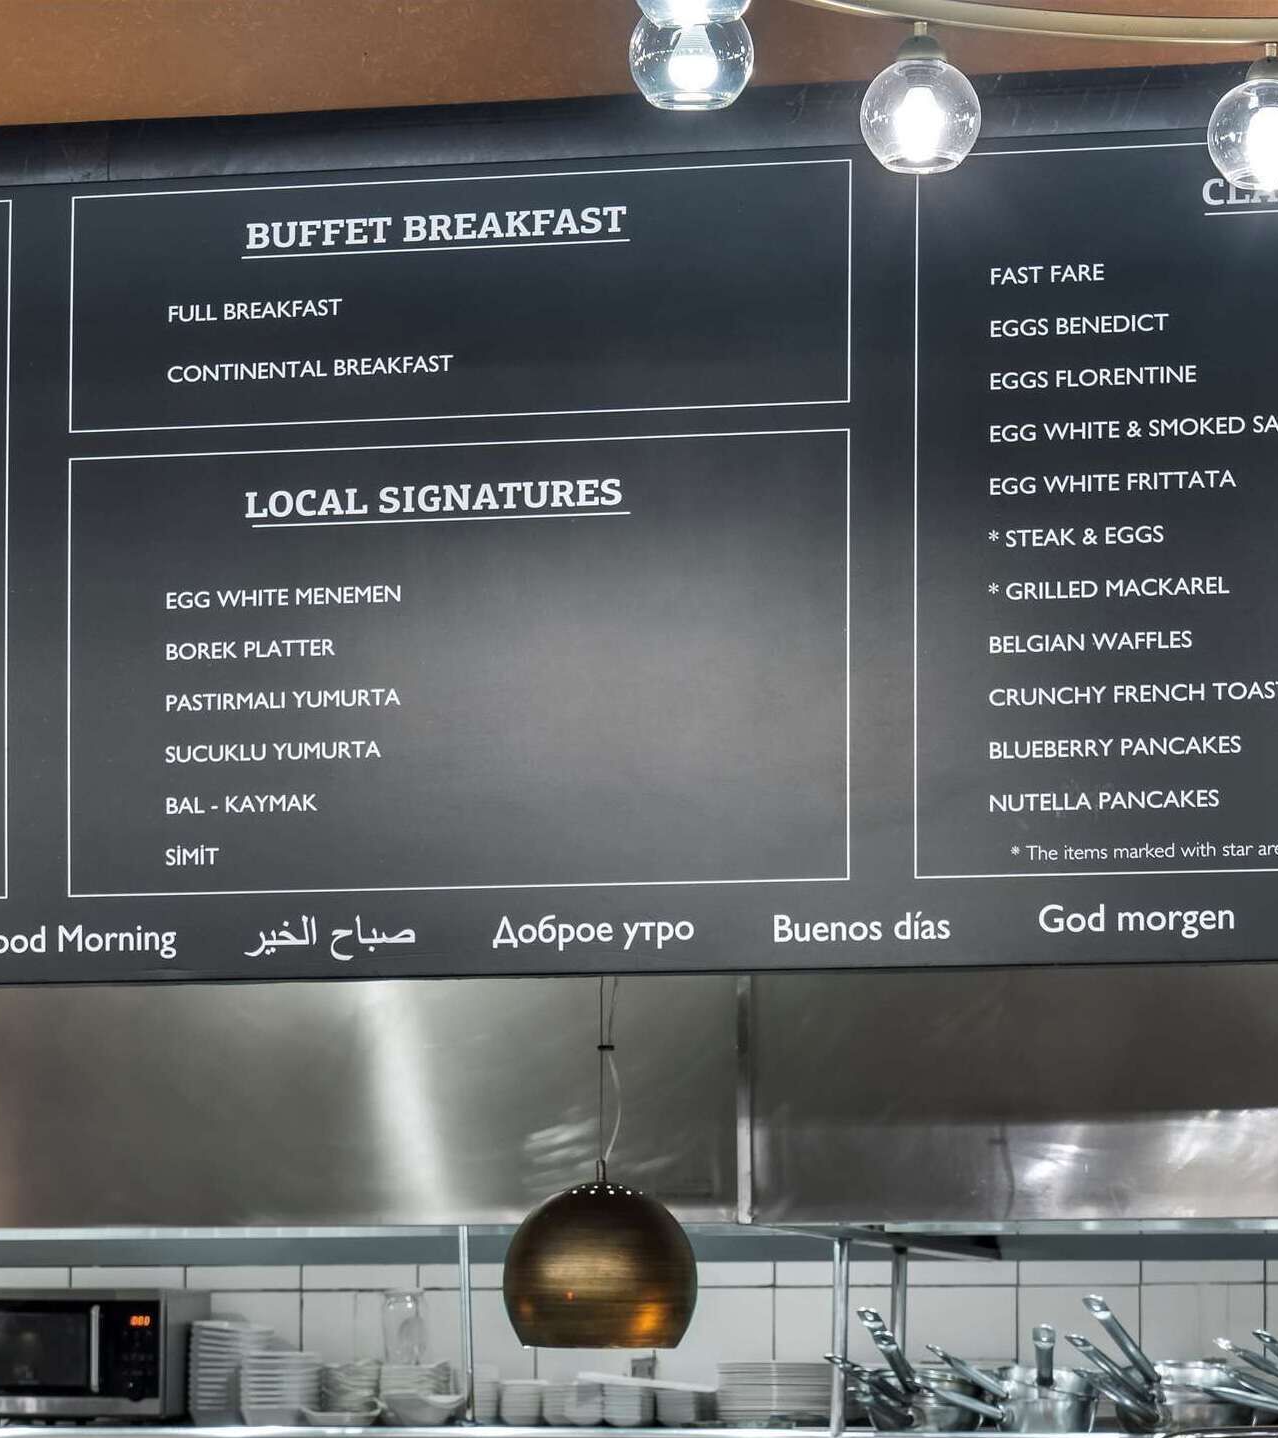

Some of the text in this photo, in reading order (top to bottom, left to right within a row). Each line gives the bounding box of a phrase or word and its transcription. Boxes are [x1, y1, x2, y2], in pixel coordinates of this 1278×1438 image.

[245, 205, 628, 250] BUFFET BREAKFAST
[990, 263, 1105, 286] FAST FARE
[167, 297, 343, 323] FULL BREAKFAST
[990, 312, 1170, 338] EGGS BENEDICT
[166, 354, 455, 384] CONTINENTAL BREAKFAST
[989, 364, 1198, 391] EGGS FLORENTINE
[989, 423, 1037, 444] EGG
[1042, 420, 1121, 441] WHITE
[1126, 420, 1143, 439] &
[1148, 415, 1246, 438] SMOKED
[989, 469, 1237, 496] EGG WHITE FRITTATA
[244, 478, 623, 519] LOCAL SIGNATURES
[1005, 524, 1165, 548] STEAK & EGGS
[165, 584, 402, 610] EGG WHITE MENEMEN
[1005, 575, 1231, 601] GRILLED MACKAREL
[165, 638, 336, 661] BOREK PLATTER
[989, 629, 1193, 654] BELGIAN WAFFLES
[165, 687, 402, 713] PASTIRMALI YUMURTA
[988, 685, 1107, 707] CRUNCHY
[1113, 682, 1206, 704] FRENCH
[164, 740, 382, 764] SUCUKLU YUMURTA
[989, 734, 1242, 760] BLUEBERRY PANCAKES
[165, 793, 318, 815] BAL KAYMAK
[989, 788, 1220, 813] NUTELLA PANCAKES
[165, 844, 220, 867] SİMİT
[1025, 844, 1059, 861] The
[1064, 846, 1108, 861] items
[1113, 842, 1176, 859] marked
[1180, 840, 1217, 858] with
[1222, 842, 1254, 857] star
[492, 914, 695, 952] Доброе утро
[773, 910, 951, 943] Buenos días
[1038, 903, 1235, 940] God morgen
[57, 924, 177, 960] Morning
[243, 914, 416, 961] صباح الخير
